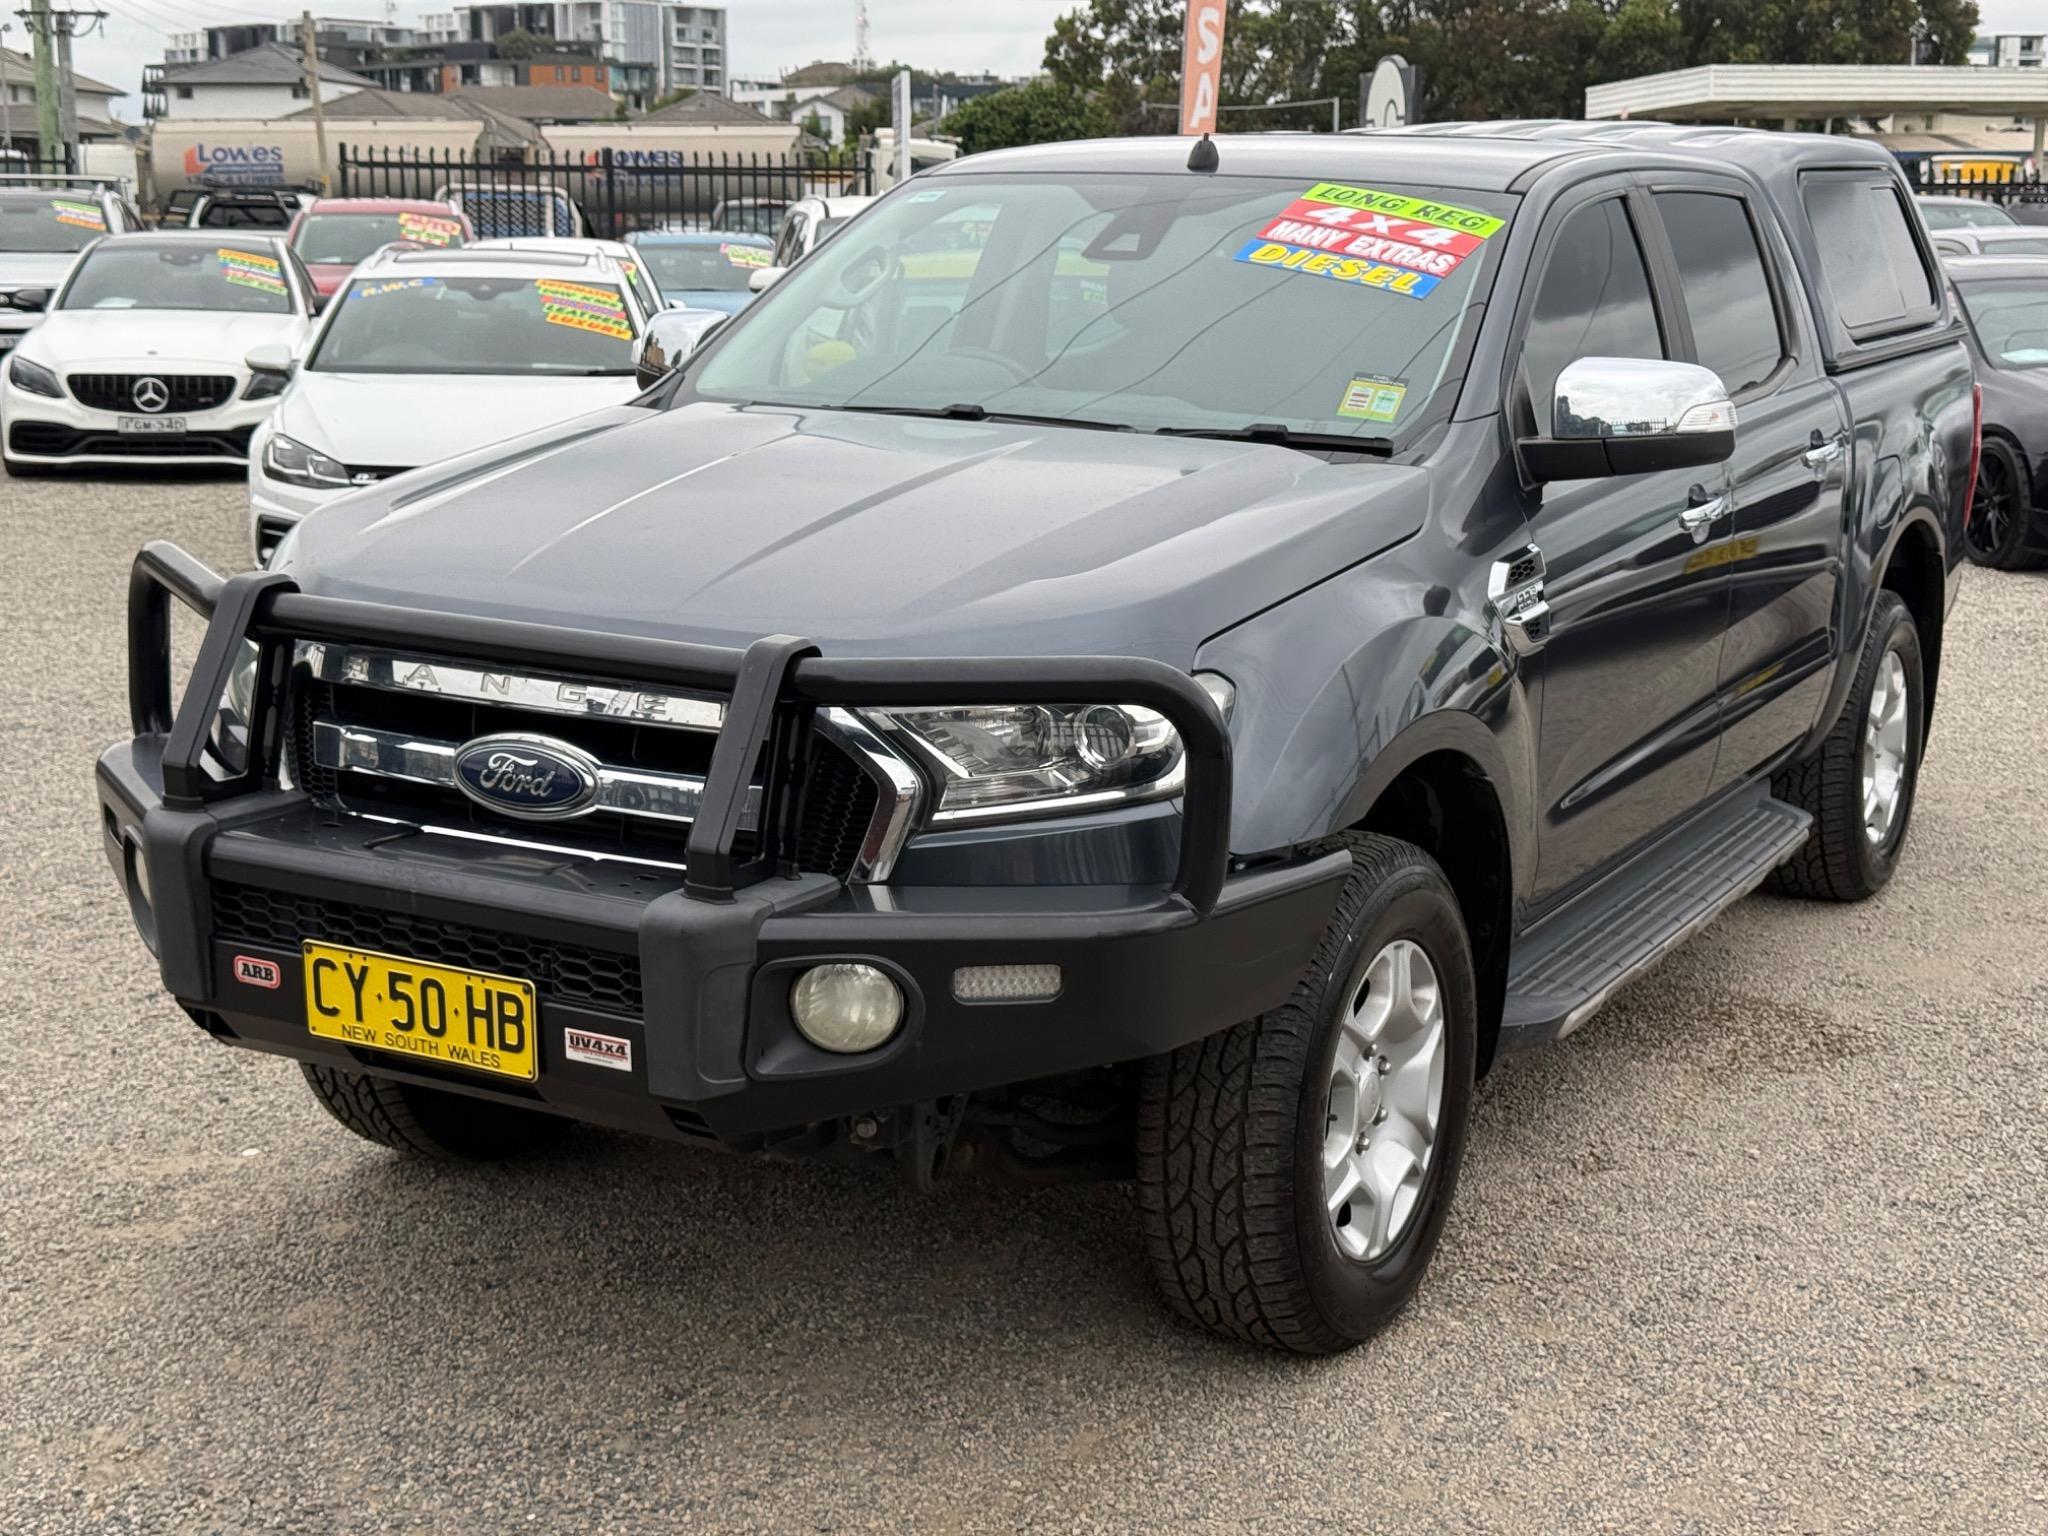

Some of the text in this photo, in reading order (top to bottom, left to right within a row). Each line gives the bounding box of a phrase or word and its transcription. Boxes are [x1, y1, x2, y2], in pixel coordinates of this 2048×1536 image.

[1316, 186, 1489, 231] LONG REG
[1247, 243, 1423, 294] DIESEL
[1266, 220, 1457, 273] MANY EXTRAS
[544, 303, 627, 327] LEATHER
[548, 312, 629, 336] LUXURY
[341, 655, 724, 721] RANGE
[480, 752, 556, 797] Ford
[241, 962, 274, 981] ARB
[342, 1024, 501, 1069] NEW SOUTH WALES
